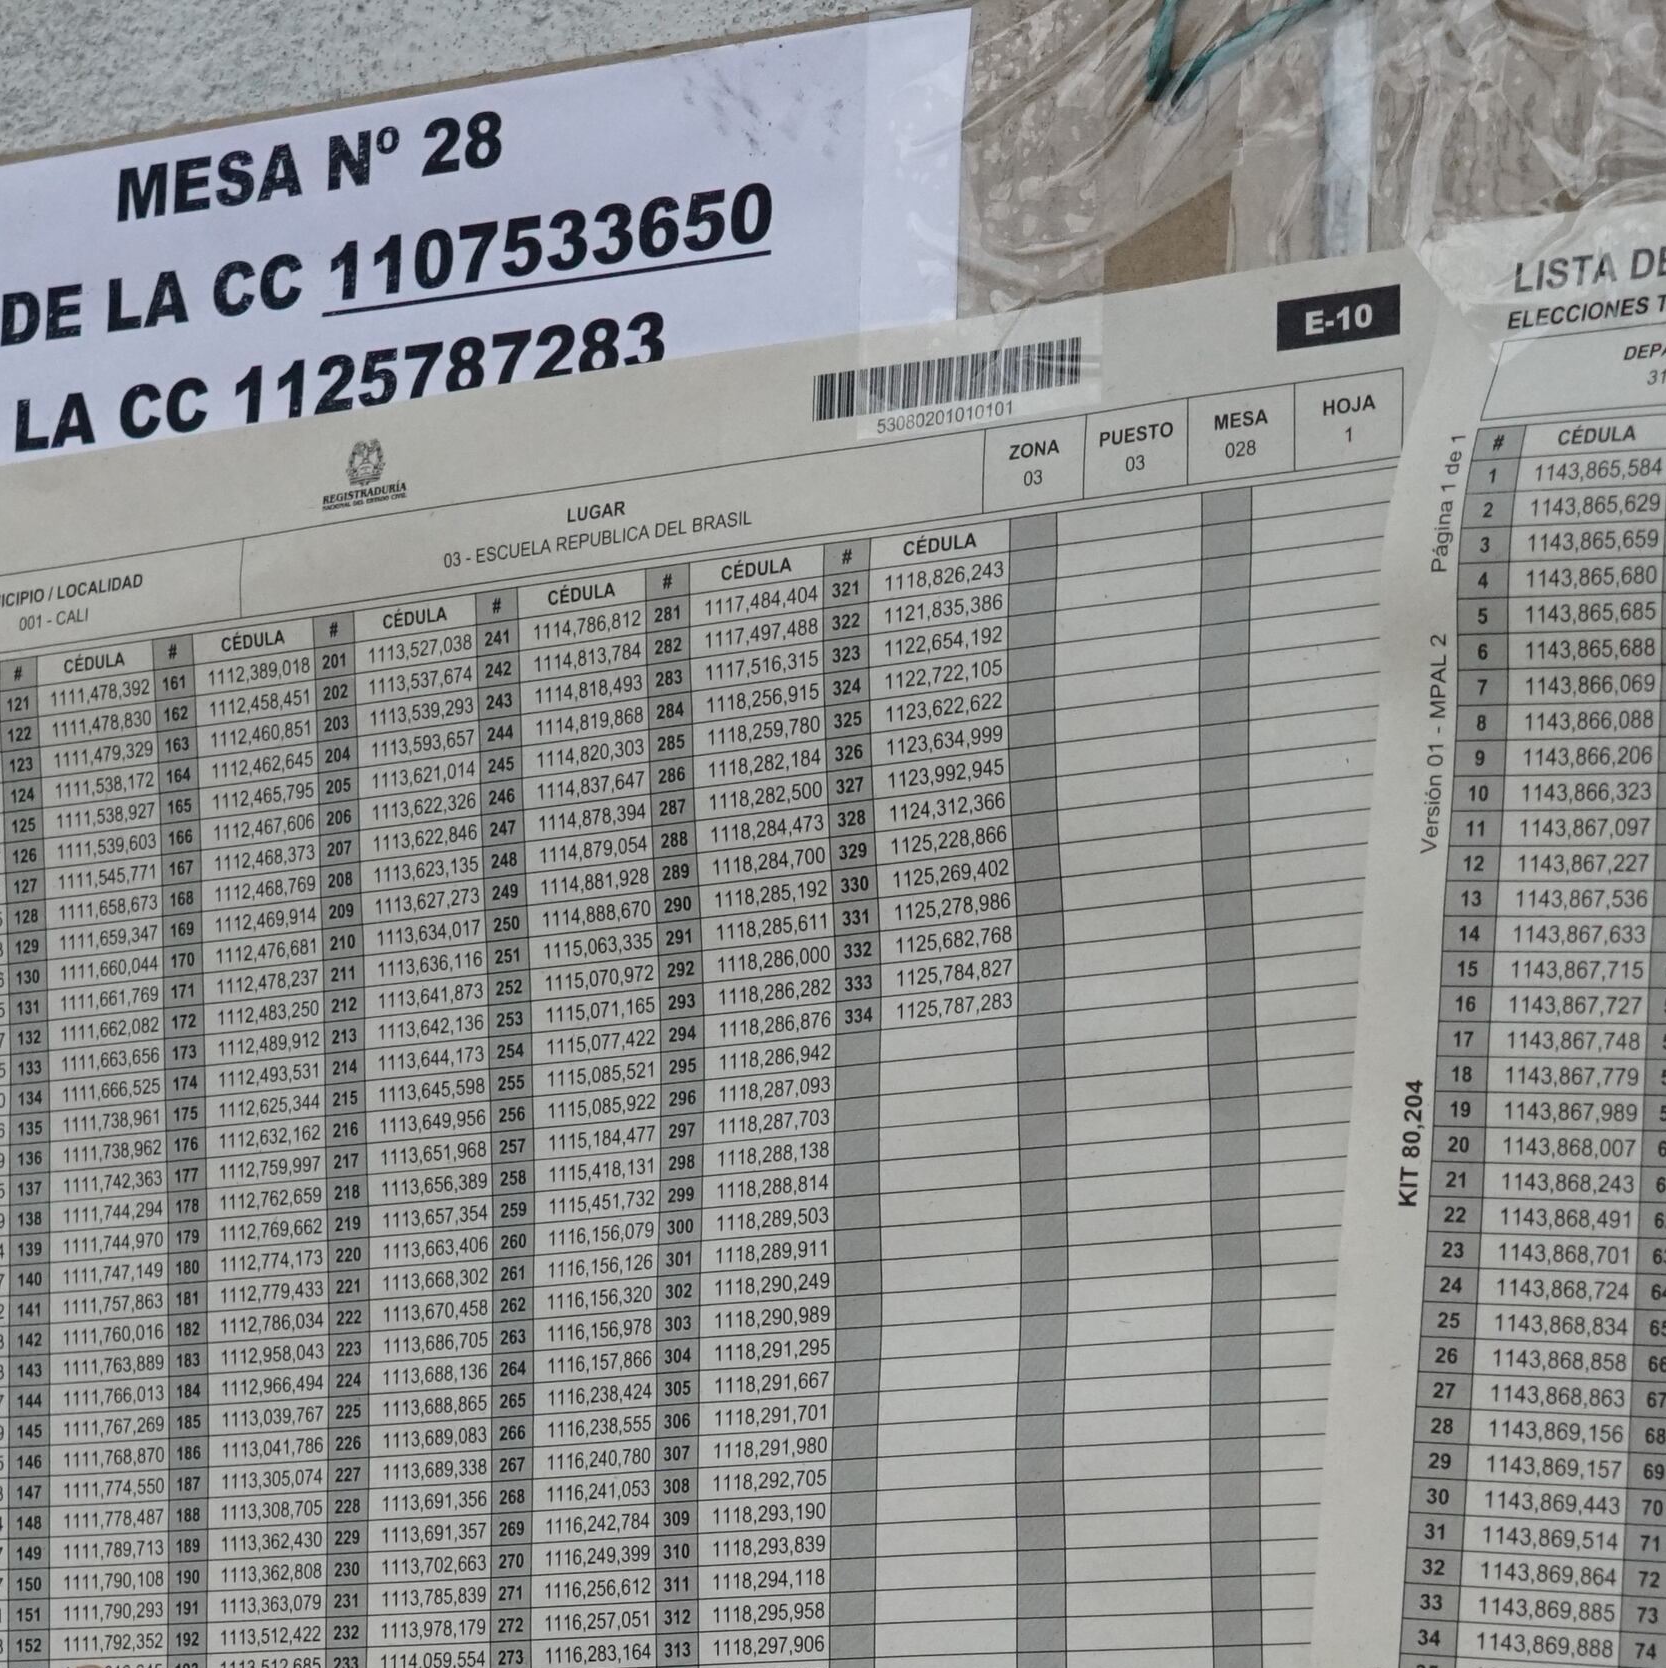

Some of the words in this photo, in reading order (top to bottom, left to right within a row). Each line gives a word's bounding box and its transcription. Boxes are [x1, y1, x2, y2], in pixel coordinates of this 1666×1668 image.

[118, 143, 302, 222] MESA
[422, 111, 501, 176] 28
[108, 271, 188, 332] LA
[214, 254, 302, 316] CC
[331, 183, 772, 300] 1107533650
[1514, 252, 1617, 293] LISTA
[1306, 304, 1372, 335] E-10
[1507, 296, 1649, 330] ELECCIONES
[15, 392, 95, 452] LA
[120, 378, 208, 438] CC
[236, 312, 664, 424] 1125787283
[876, 401, 1014, 434] 53080201010101
[1323, 394, 1376, 416] HOJA
[1214, 409, 1268, 431] MESA
[1100, 422, 1173, 448] PUESTO
[1345, 426, 1352, 443] 1
[1009, 439, 1059, 460] ZONA
[1225, 440, 1256, 459] 028
[1126, 455, 1145, 472] 03
[1534, 457, 1663, 483] 1143,865,584
[1024, 469, 1042, 486] 03
[322, 481, 407, 505] REGISTRADURÍA
[567, 501, 625, 523] LUGAR
[444, 552, 461, 568] 03
[476, 539, 551, 563] ESCUELA
[557, 525, 650, 551] REPUBLICA
[655, 520, 687, 538] DEL
[693, 511, 752, 533] BRASIL
[903, 533, 977, 556] CÉDULA
[721, 557, 792, 581] CÉDULA
[885, 561, 1003, 591] 1118,826,243
[57, 574, 143, 599] LOCALIDAD
[705, 585, 818, 616] 1117,484,404
[832, 580, 858, 598] 321
[19, 614, 41, 631] 001
[56, 608, 88, 625] CALI
[885, 593, 1002, 624] 1121,835,386
[1402, 1080, 1424, 1158] 80,204
[1398, 1166, 1418, 1207] KIT
